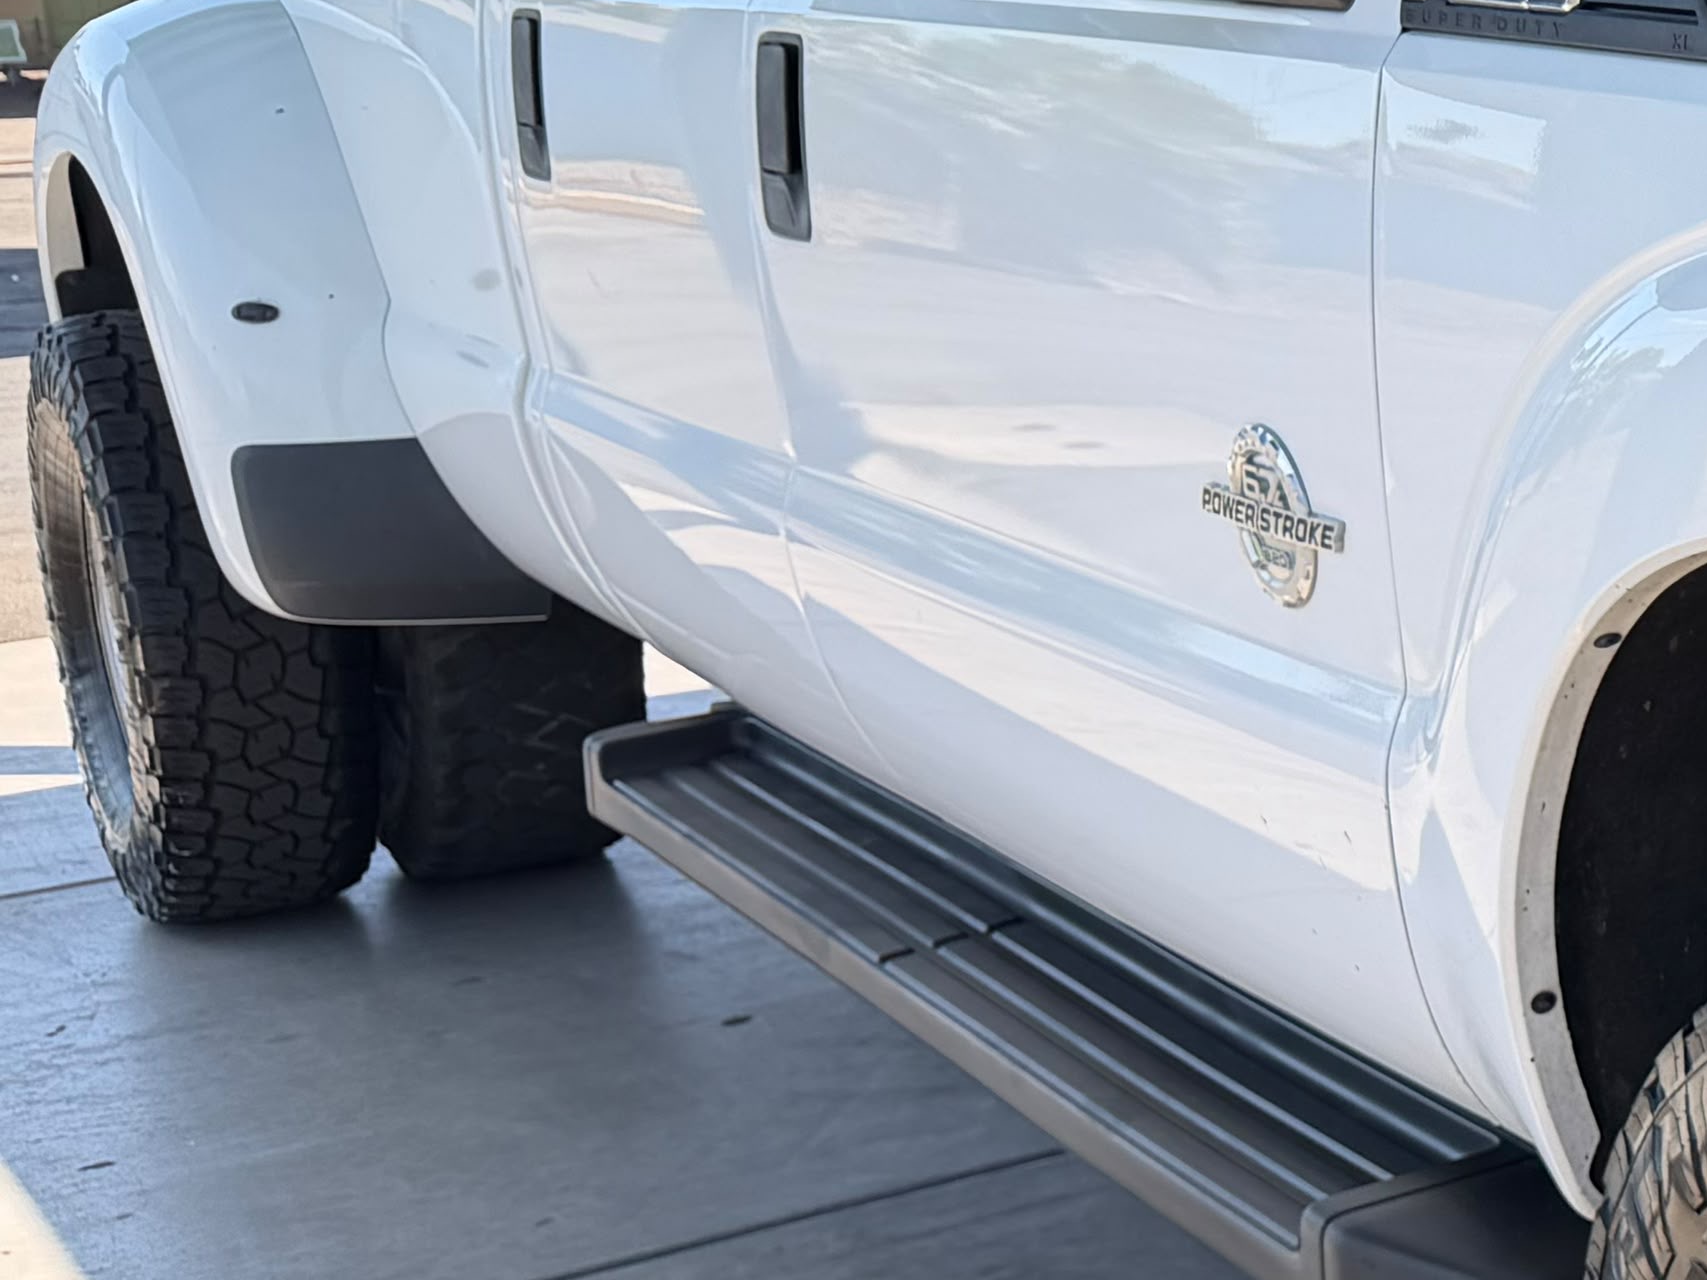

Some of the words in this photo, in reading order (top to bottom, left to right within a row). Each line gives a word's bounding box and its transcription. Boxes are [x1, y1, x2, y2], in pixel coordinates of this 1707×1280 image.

[1404, 8, 1483, 31] SUPER
[1496, 16, 1563, 38] DUTY
[1202, 488, 1257, 531] POWER
[1258, 506, 1335, 551] STROKE
